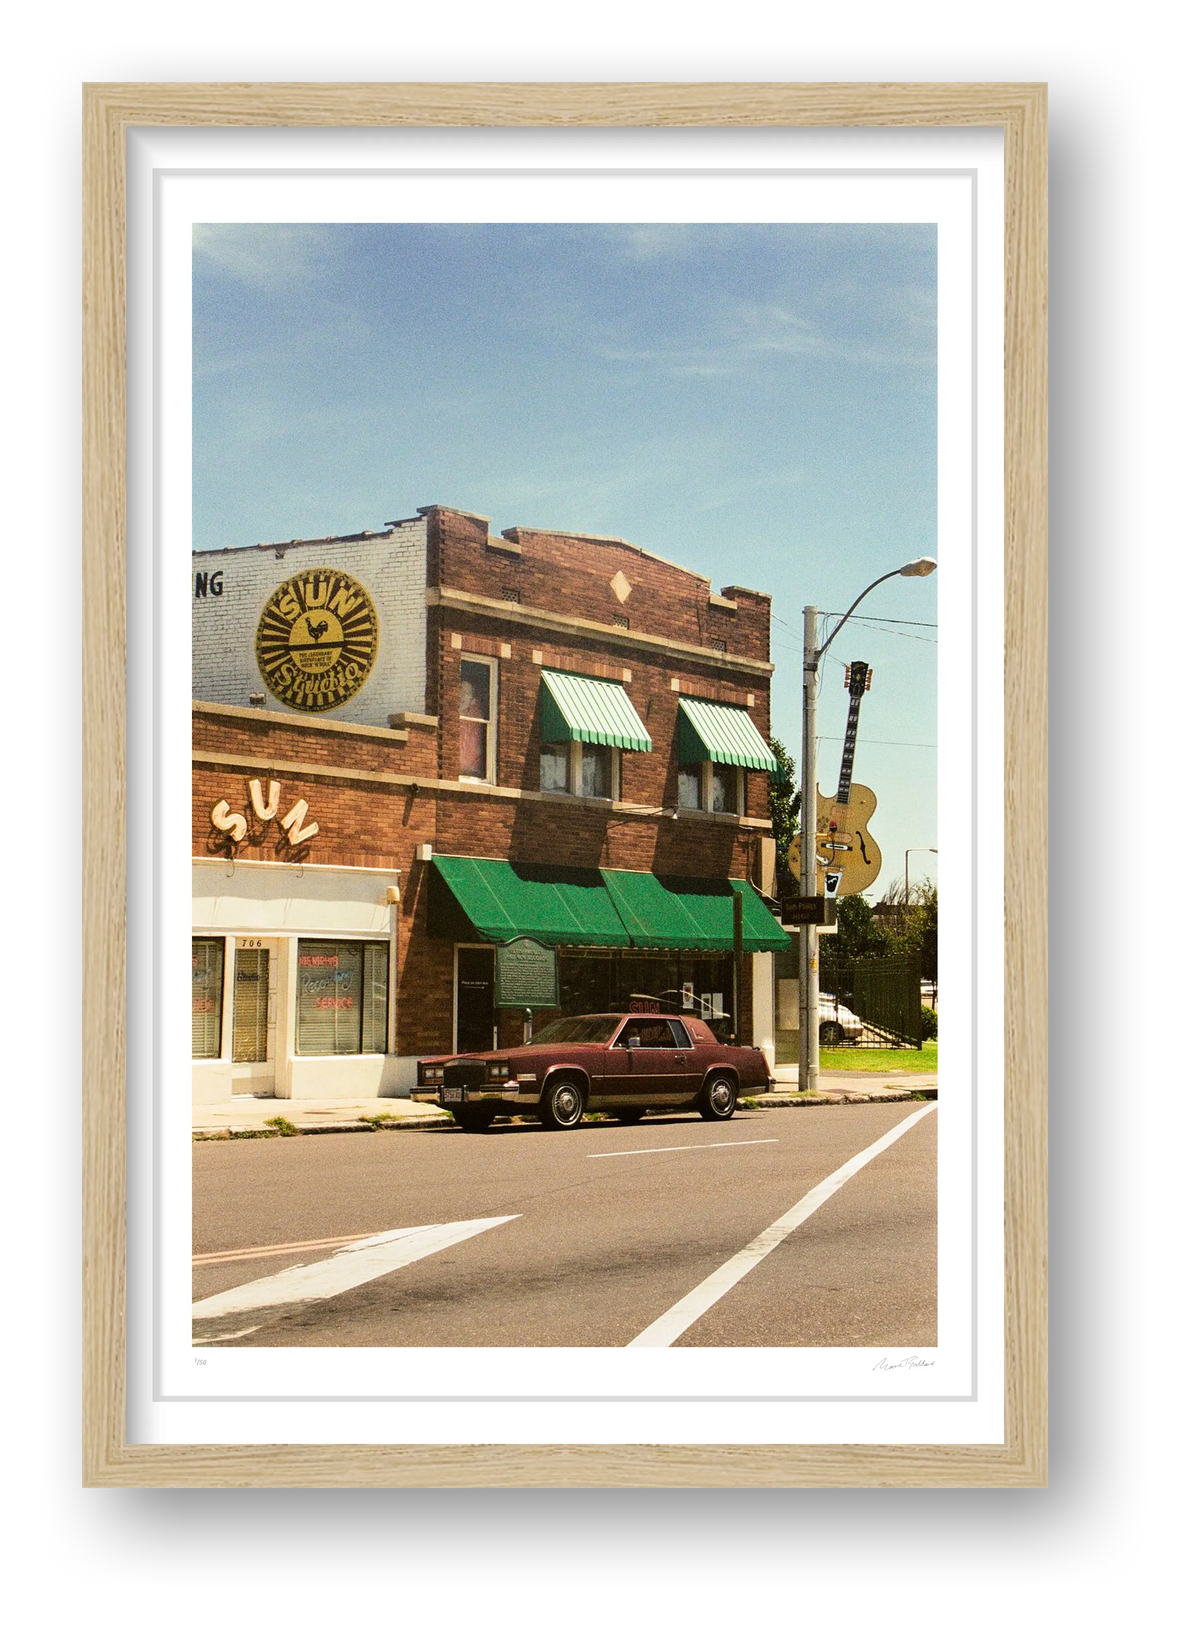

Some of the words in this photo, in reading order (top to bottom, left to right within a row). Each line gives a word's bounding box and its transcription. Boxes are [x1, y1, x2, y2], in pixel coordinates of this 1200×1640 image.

[194, 570, 224, 599] NG
[279, 581, 362, 620] SUN
[273, 661, 360, 695] Studio
[211, 779, 320, 846] SUN
[242, 939, 262, 948] 706
[316, 996, 354, 1011] SERVICE
